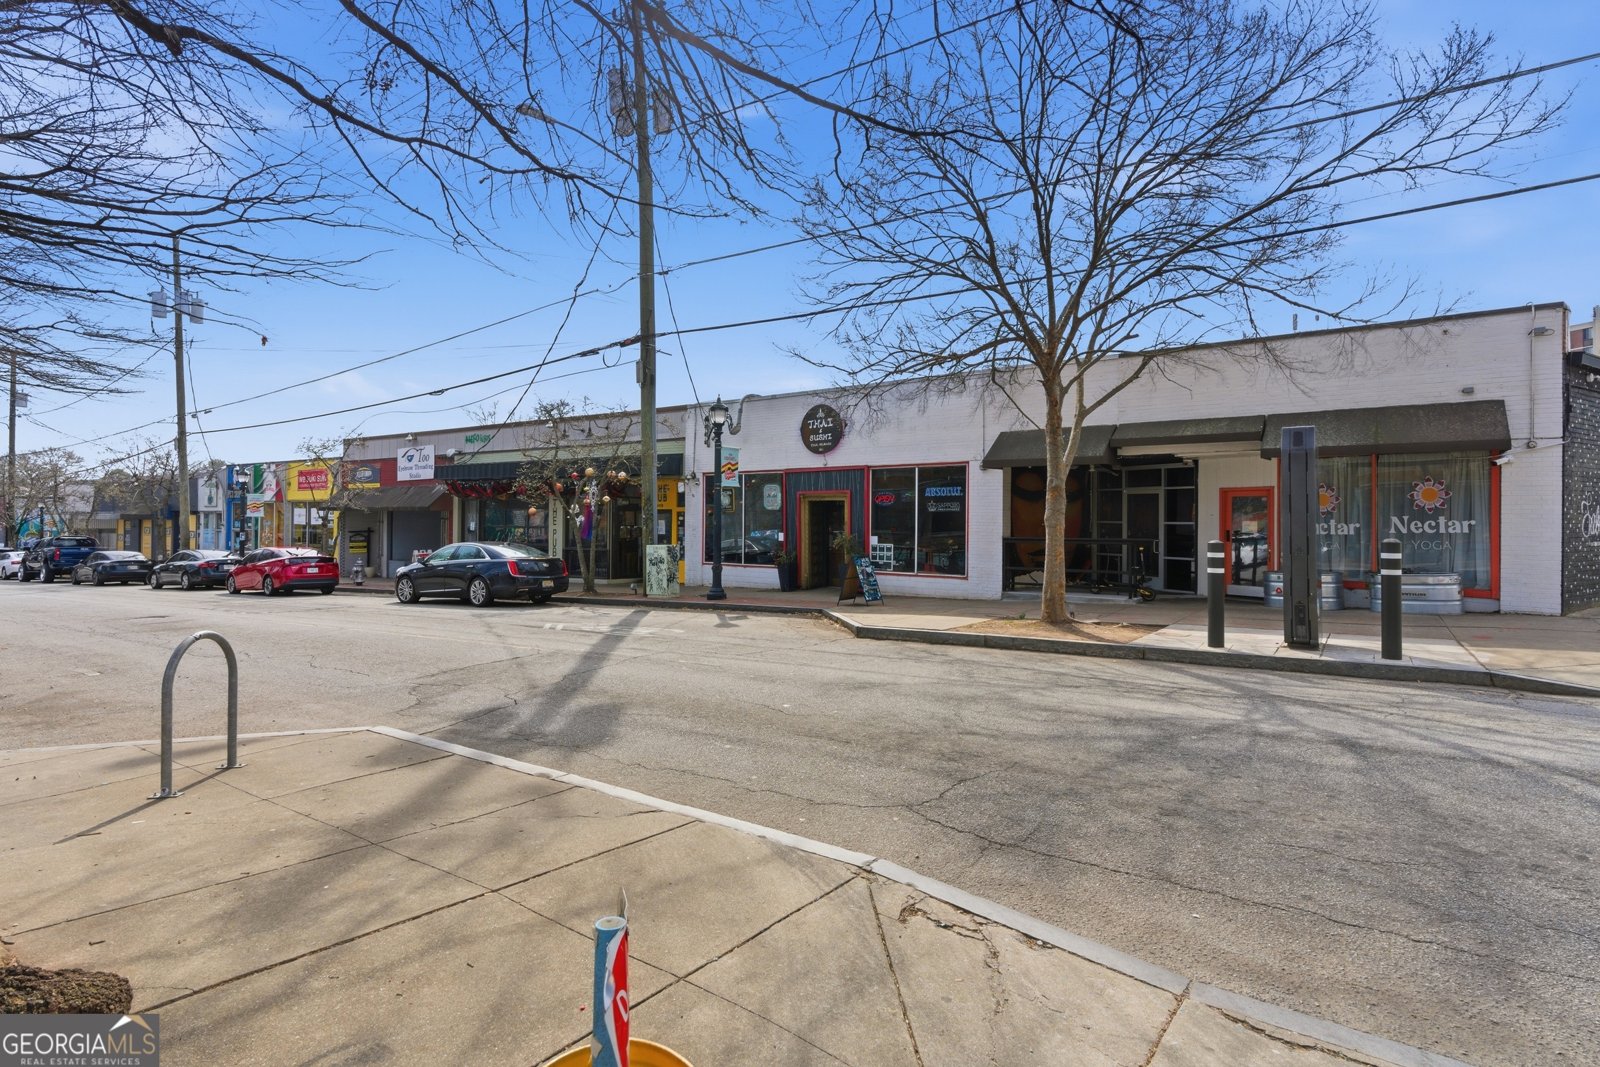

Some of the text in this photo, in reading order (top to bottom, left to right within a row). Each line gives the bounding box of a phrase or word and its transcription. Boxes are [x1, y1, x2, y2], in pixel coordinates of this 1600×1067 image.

[807, 418, 833, 428] THAI
[809, 433, 833, 441] SUSHI
[417, 446, 430, 462] Too
[414, 463, 434, 471] Threading
[657, 484, 669, 493] HE
[657, 493, 668, 502] UB
[1315, 519, 1360, 536] ctar
[1388, 515, 1476, 534] Nectar
[1411, 540, 1453, 551] YOGA
